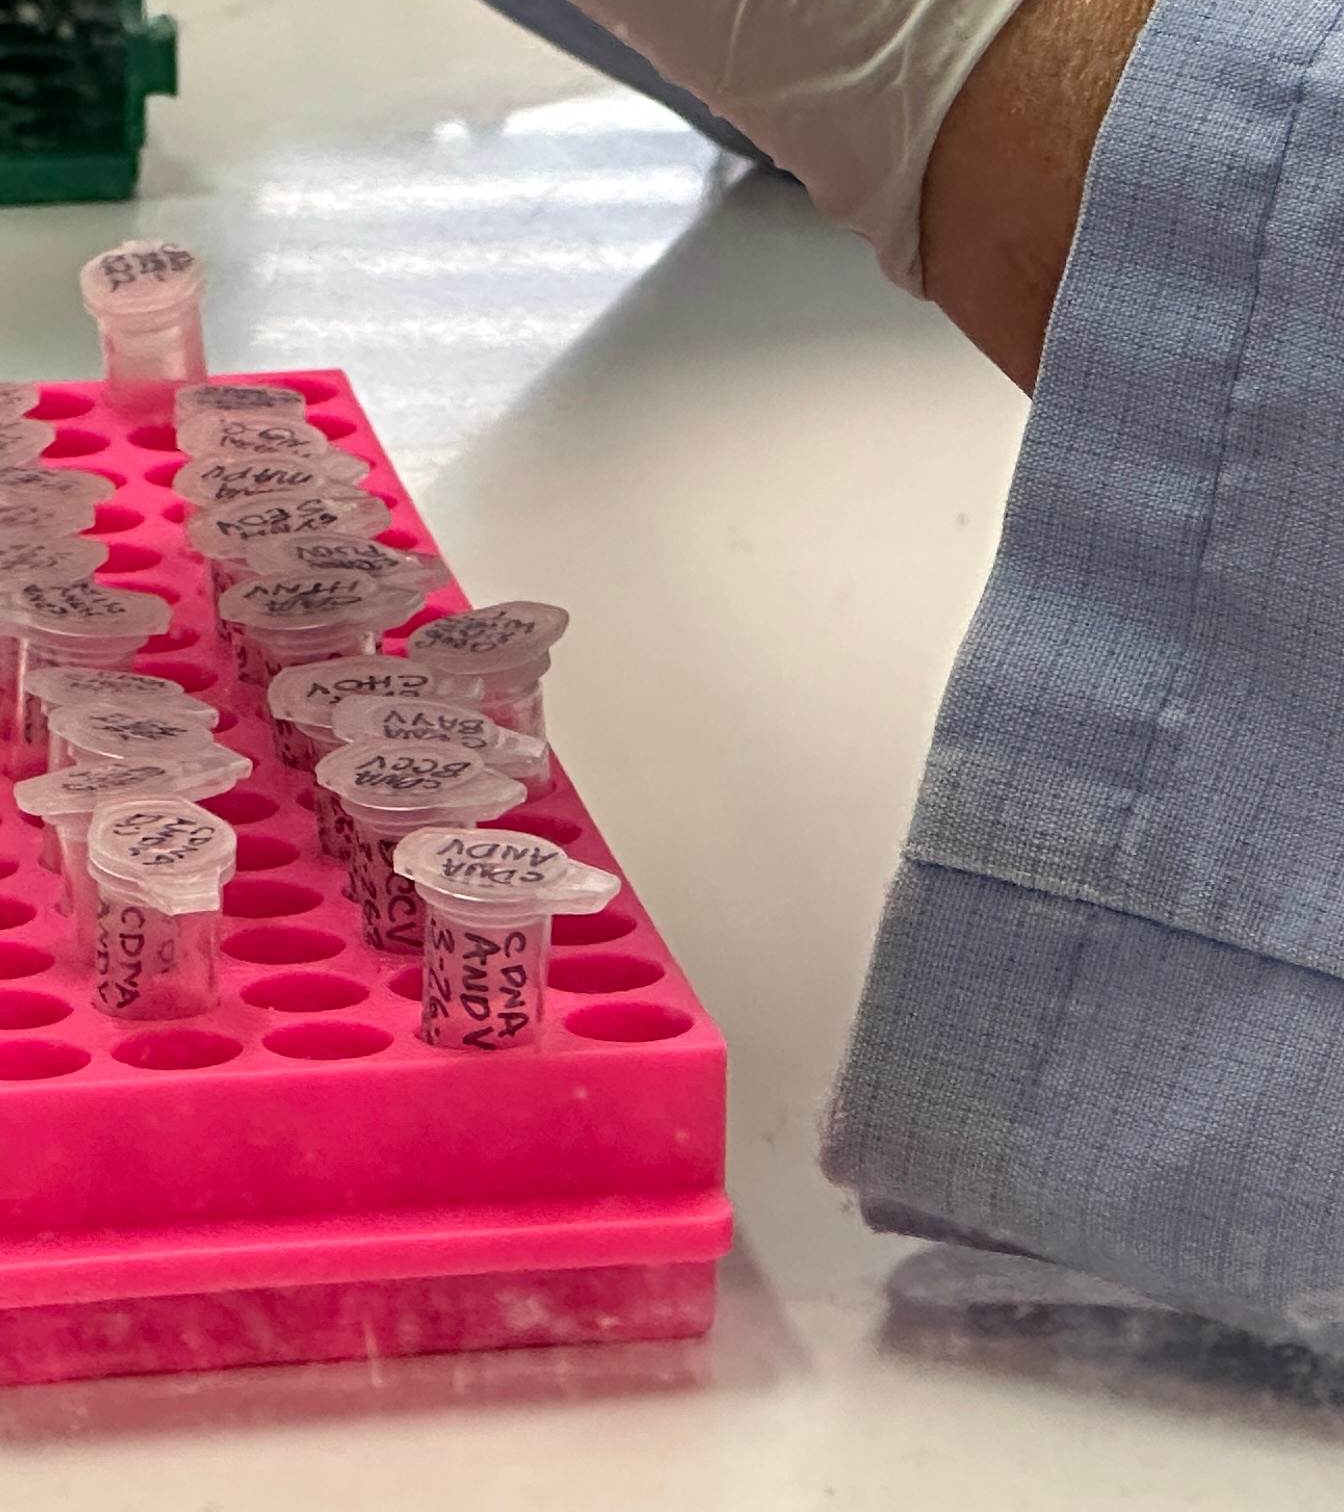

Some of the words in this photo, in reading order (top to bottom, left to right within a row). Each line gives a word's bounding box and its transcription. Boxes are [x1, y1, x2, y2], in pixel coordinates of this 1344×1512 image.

[306, 674, 430, 698] CHOV
[383, 710, 485, 735] BAYV
[355, 755, 472, 778] BCCV
[436, 838, 560, 867] ANDV
[114, 905, 146, 1008] CDNA
[459, 931, 502, 1051] ANDV
[497, 931, 530, 1038] CDNA
